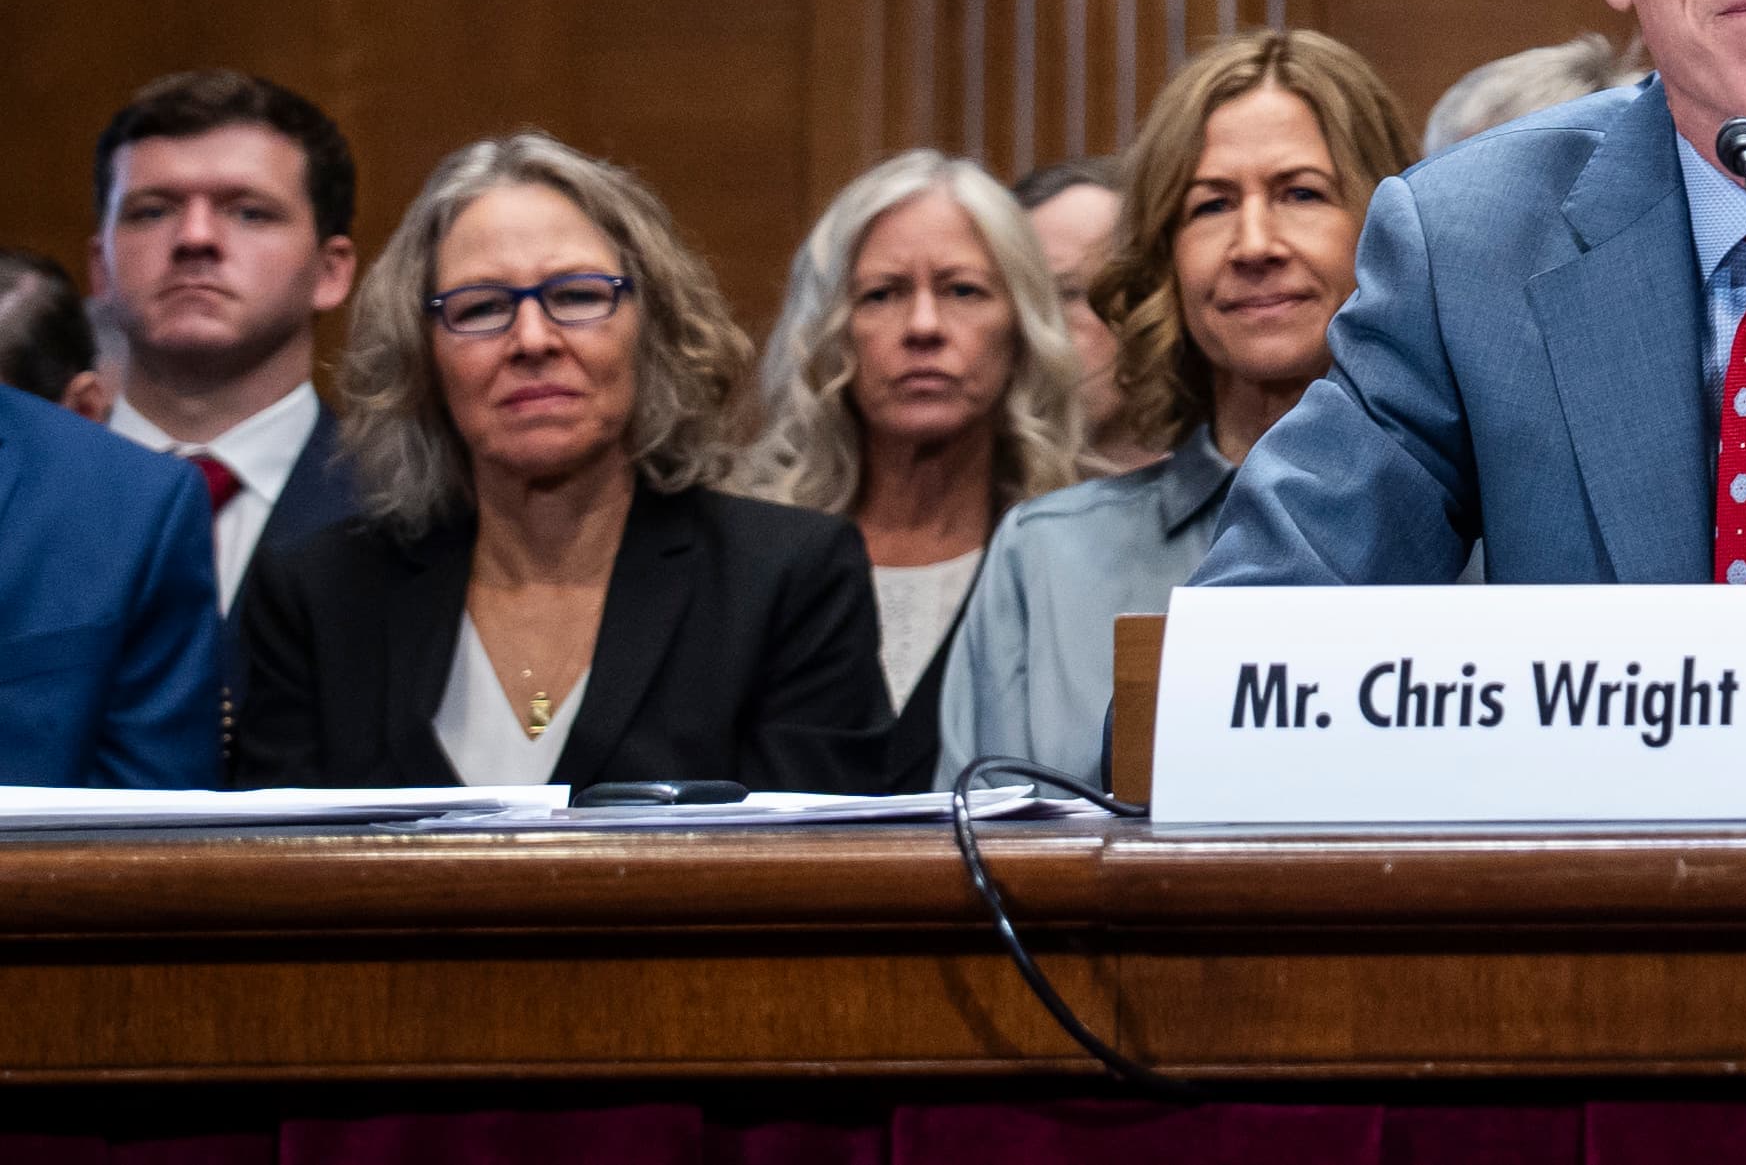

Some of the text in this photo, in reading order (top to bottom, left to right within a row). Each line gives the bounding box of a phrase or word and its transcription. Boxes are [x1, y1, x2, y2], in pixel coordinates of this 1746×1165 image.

[1231, 657, 1738, 748] Mr. Chris Wright
